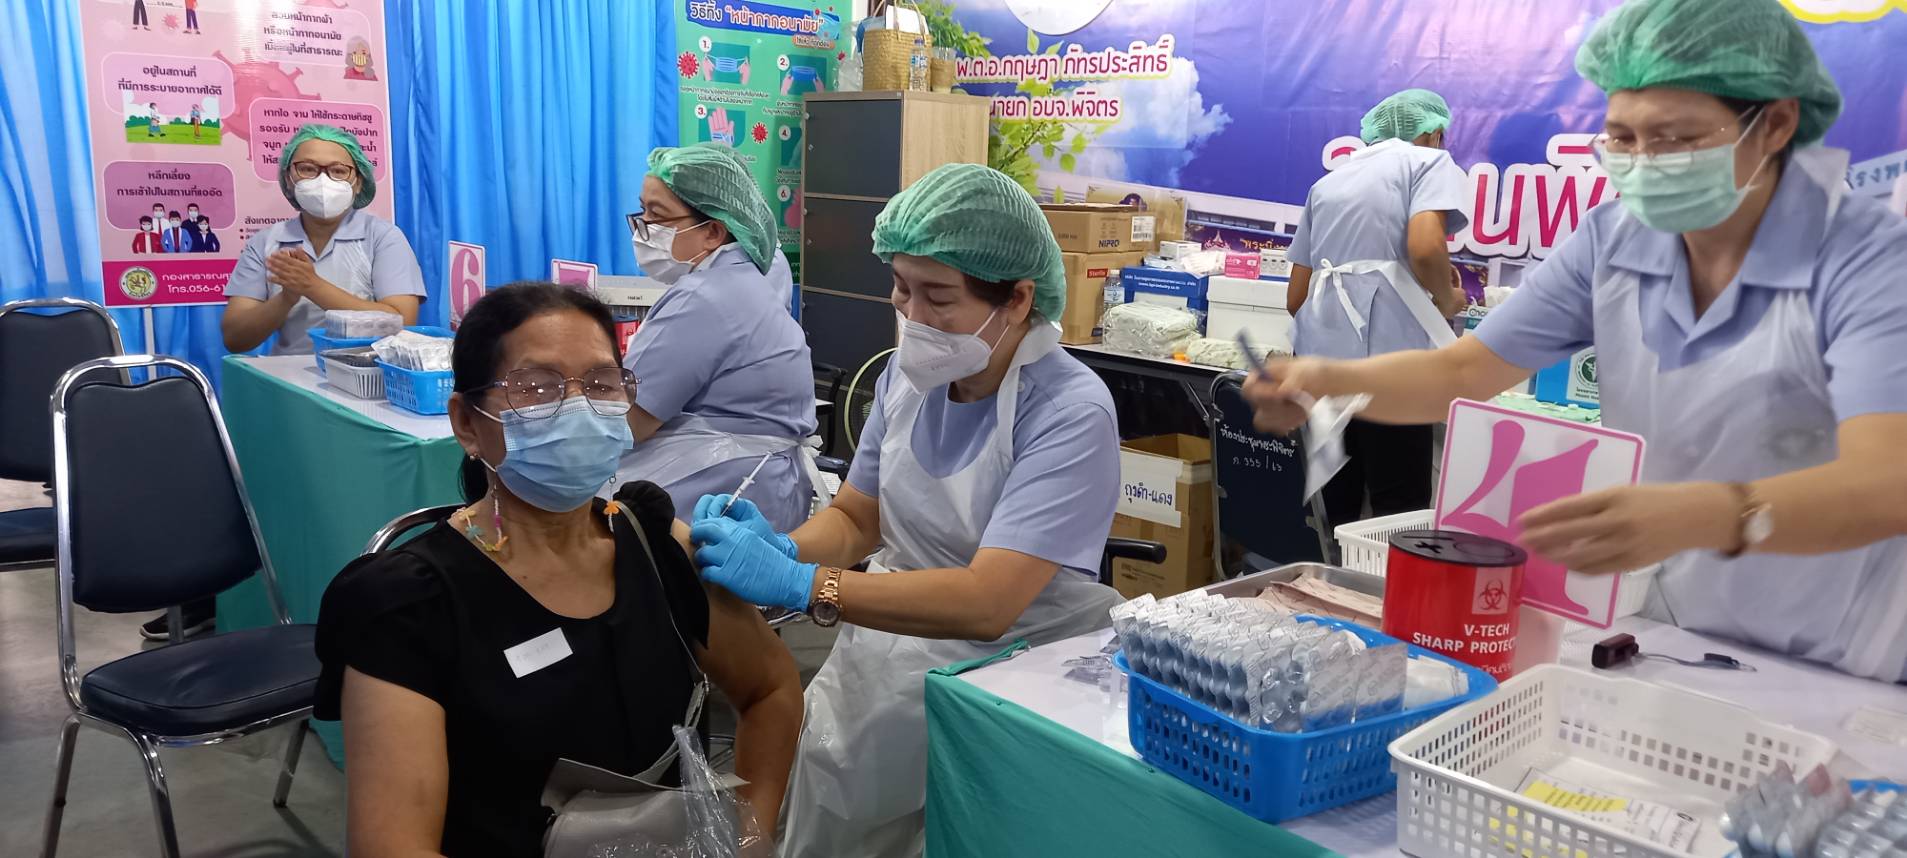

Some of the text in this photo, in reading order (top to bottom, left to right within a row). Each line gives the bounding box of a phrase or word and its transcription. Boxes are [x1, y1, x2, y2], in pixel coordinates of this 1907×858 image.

[957, 57, 1058, 81] พ.ต.อ.กฤษฎา
[1032, 91, 1119, 117] อบจ.พิจิตร
[1098, 239, 1121, 248] NIPRO
[451, 249, 481, 319] 6
[1463, 623, 1510, 638] V-TECH
[1412, 631, 1518, 654] SHARP PROTEC
